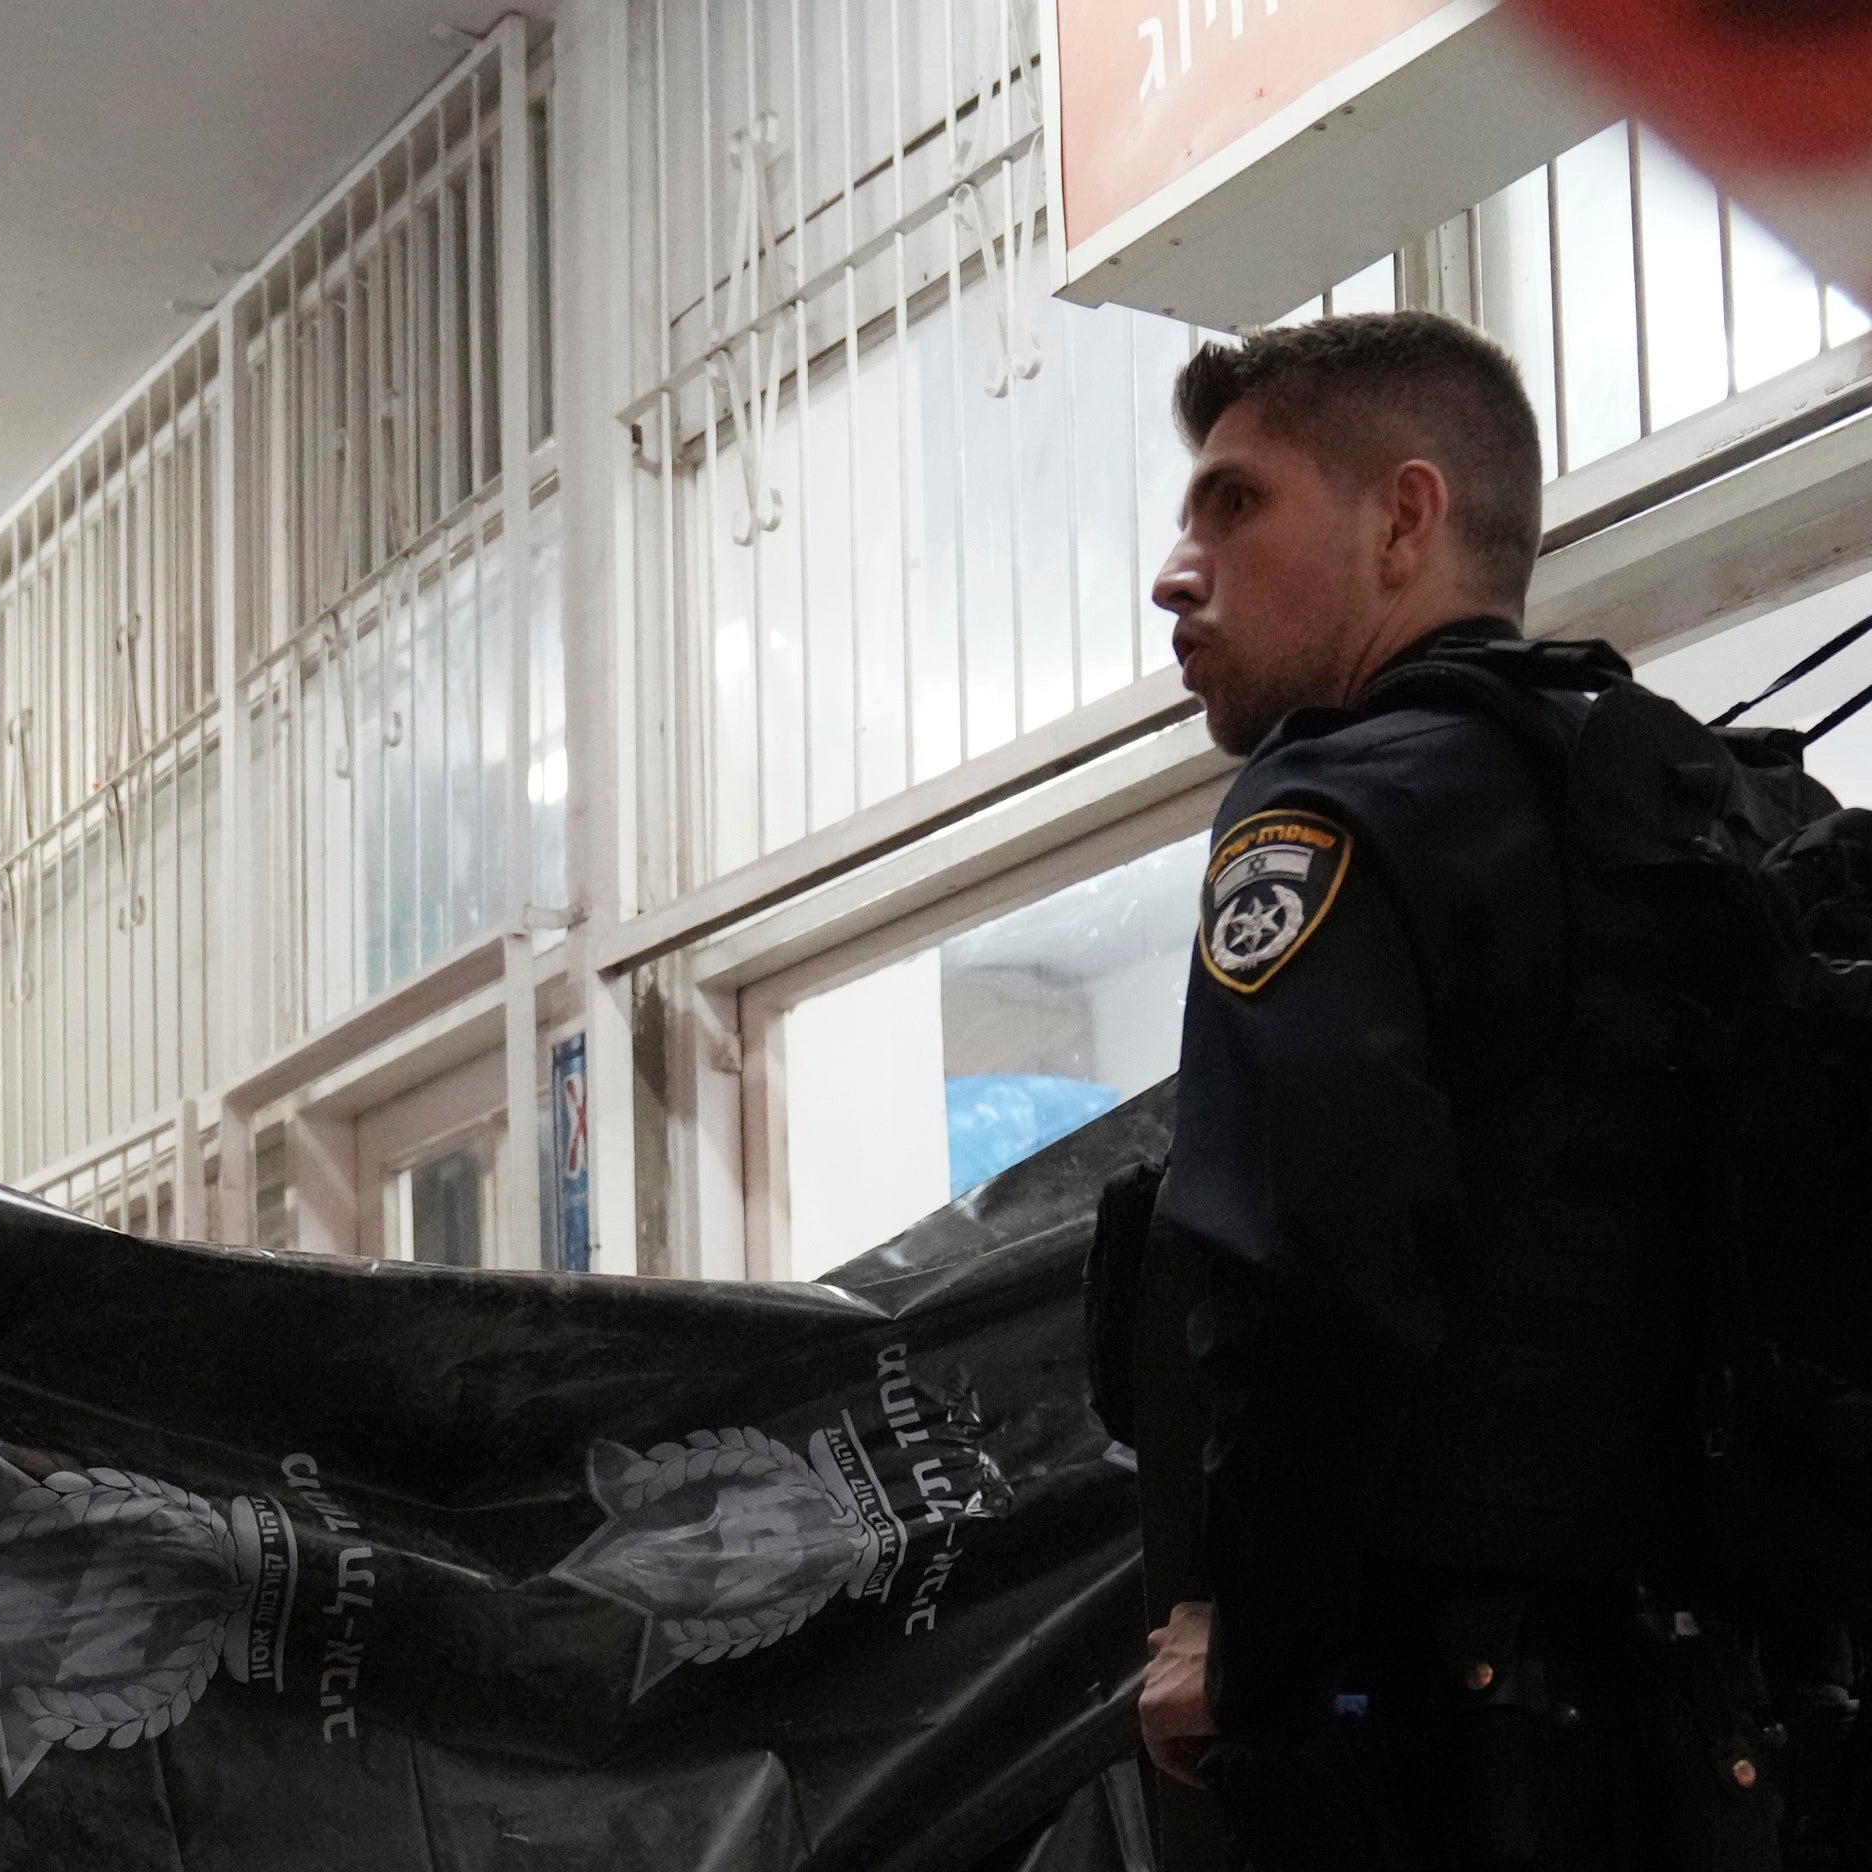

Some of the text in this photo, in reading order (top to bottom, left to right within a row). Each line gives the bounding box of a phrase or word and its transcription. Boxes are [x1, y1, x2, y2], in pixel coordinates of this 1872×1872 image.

[562, 1074, 590, 1179] X
[823, 1427, 856, 1472] זיהוי
[848, 1477, 898, 1555] קורבנות
[877, 1342, 964, 1636] מחוז תל-אביב
[249, 1496, 288, 1681] זיהוי קורבנות אסון
[278, 1452, 376, 1743] מחוז תל-אביב
